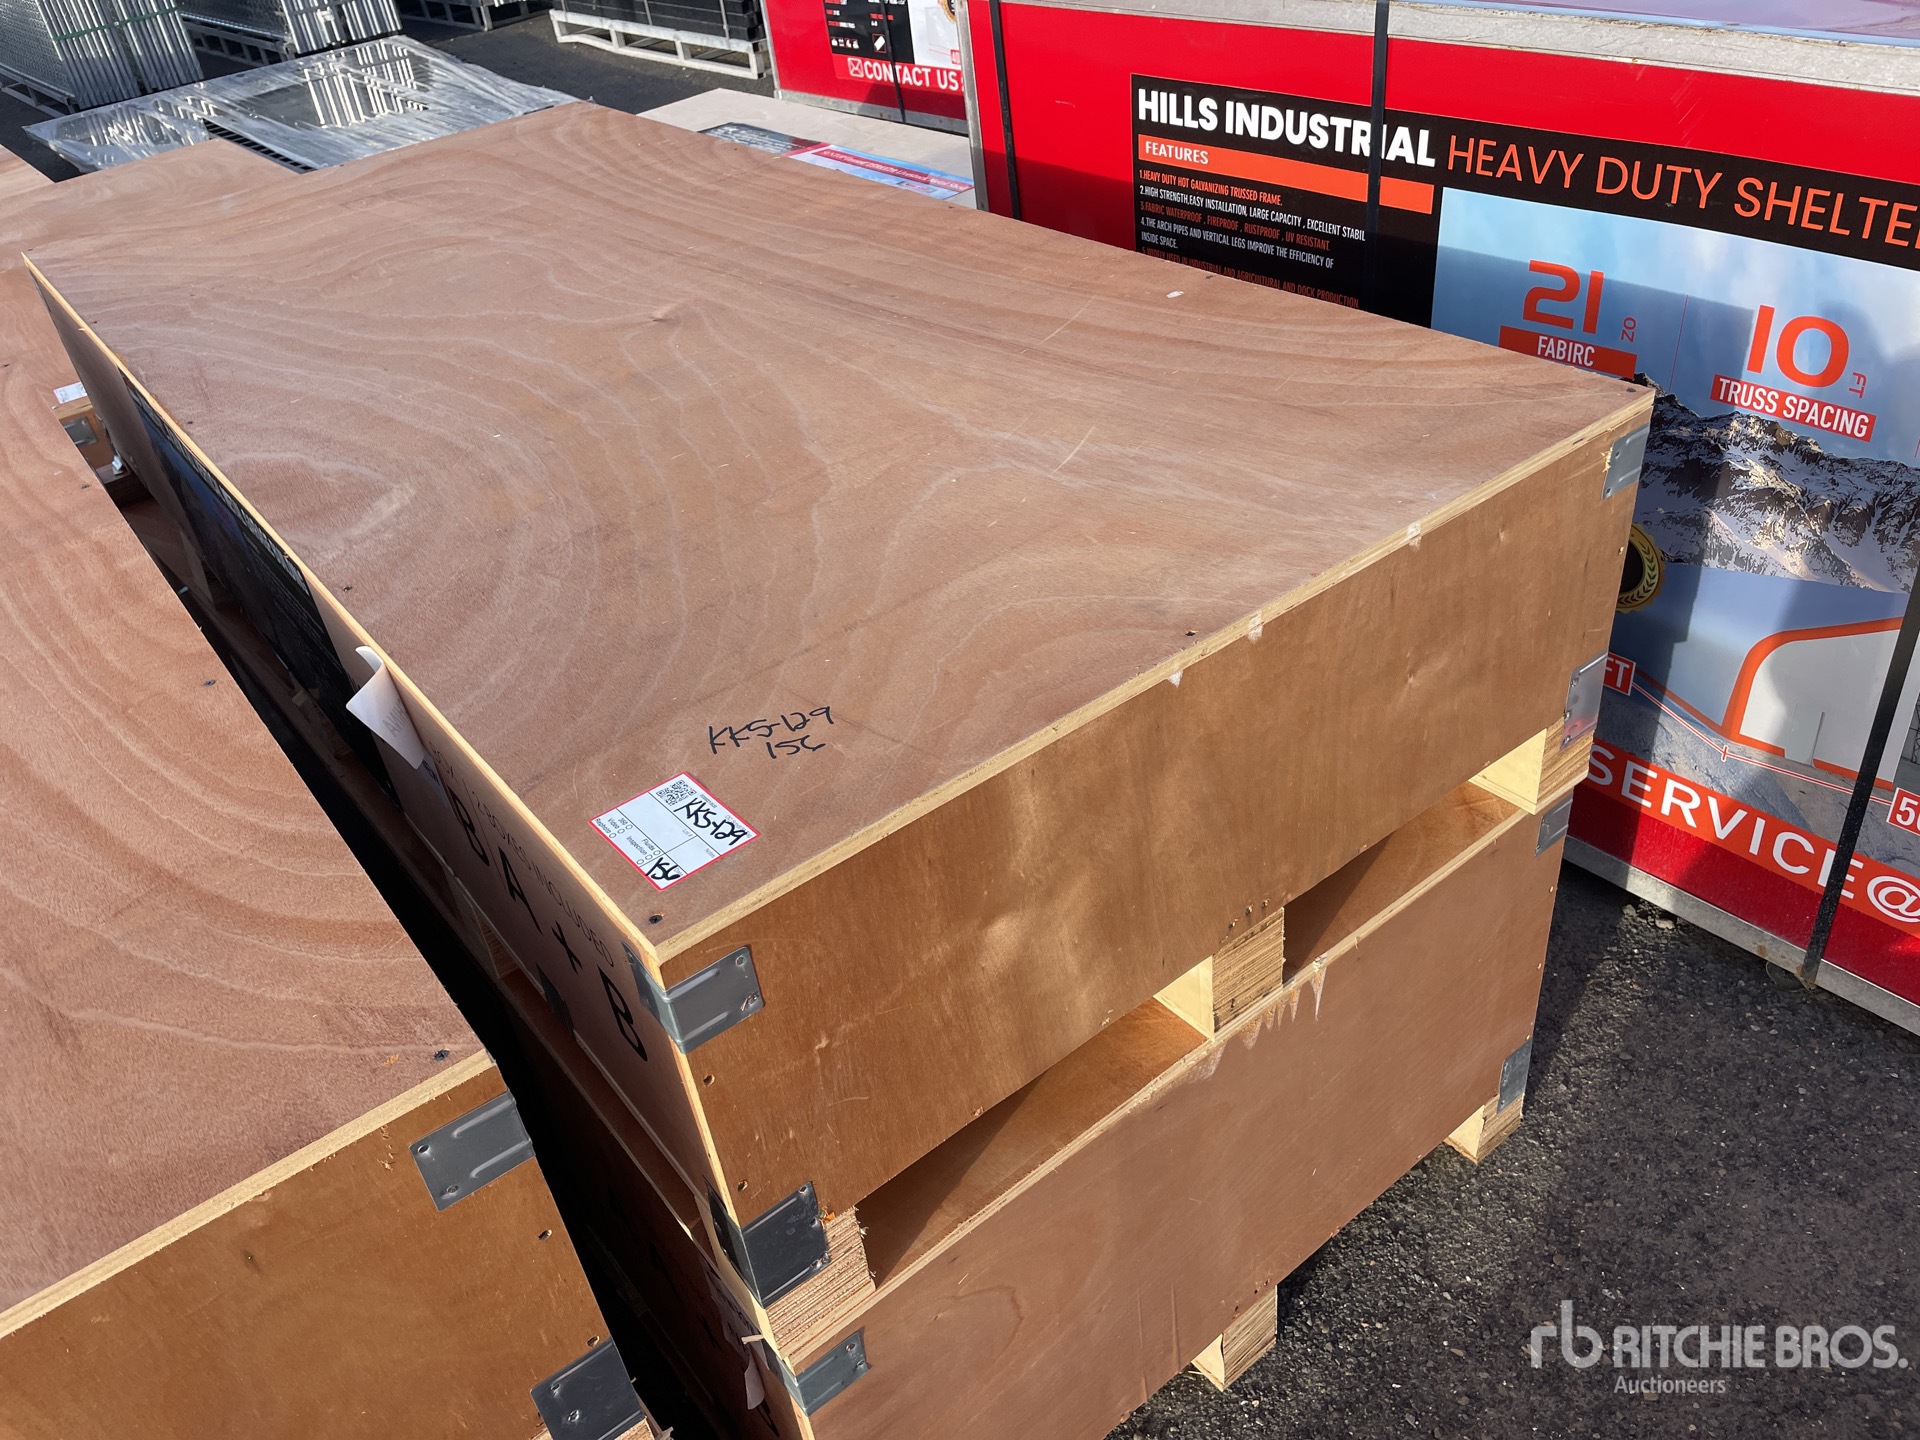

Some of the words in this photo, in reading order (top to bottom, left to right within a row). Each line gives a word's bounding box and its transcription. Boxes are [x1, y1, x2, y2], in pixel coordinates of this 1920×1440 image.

[864, 61, 931, 87] CONTACT
[1138, 88, 1218, 131] HILLS
[1447, 135, 1585, 189] HEAVY
[1596, 156, 1722, 209] DUTY
[1734, 177, 1920, 249] SHELTE
[1145, 141, 1209, 165] FEATURES
[1140, 170, 1160, 182] 1.HEAVY
[1162, 173, 1176, 185] DUTY
[1178, 177, 1189, 188] HOT
[1191, 179, 1228, 196] GALVANIZING
[1230, 186, 1257, 200] TRUSSED
[1260, 192, 1282, 206] FRAME.
[1140, 185, 1158, 197] 2.HIGH
[1205, 198, 1248, 217] INSTALLATION,
[1249, 207, 1269, 220] LARGE
[1270, 211, 1301, 226] CAPACITY
[1307, 219, 1341, 236] EXCELLENT
[1140, 201, 1164, 215] 3.FABRIC
[1166, 206, 1202, 223] WATERPROOF
[1207, 215, 1239, 230] FIREPROOF
[1244, 223, 1280, 239] RUSTPROOF
[1285, 231, 1295, 242] UV
[1296, 233, 1330, 251] RESISTANT.
[1140, 216, 1156, 228] 4.THE
[1157, 221, 1172, 232] ARCH
[1173, 223, 1188, 236] PIPES
[1189, 228, 1201, 238] AND
[1202, 231, 1230, 246] VERTICAL
[1231, 237, 1246, 249] LEGS
[1247, 240, 1274, 255] IMPROVE
[1276, 246, 1288, 258] THE
[1289, 249, 1325, 267] EFFICIENCY
[1325, 257, 1334, 269] OF
[1141, 231, 1158, 244] INSIDE
[1159, 235, 1178, 249] SPACE.
[1282, 281, 1295, 292] AND
[1297, 284, 1315, 297] DOCK
[1317, 289, 1359, 308] PRODUCTION
[1523, 259, 1604, 335] 21
[1537, 335, 1595, 368] FABIRC
[1746, 304, 1850, 388] 10
[1718, 377, 1778, 414] TRUSS
[1782, 395, 1869, 438] SPACING
[1847, 371, 1867, 399] FT
[448, 785, 490, 866] B
[1896, 796, 1920, 827] 5
[532, 860, 615, 968] INCLUDED
[498, 847, 543, 936] A
[599, 966, 648, 1062] B
